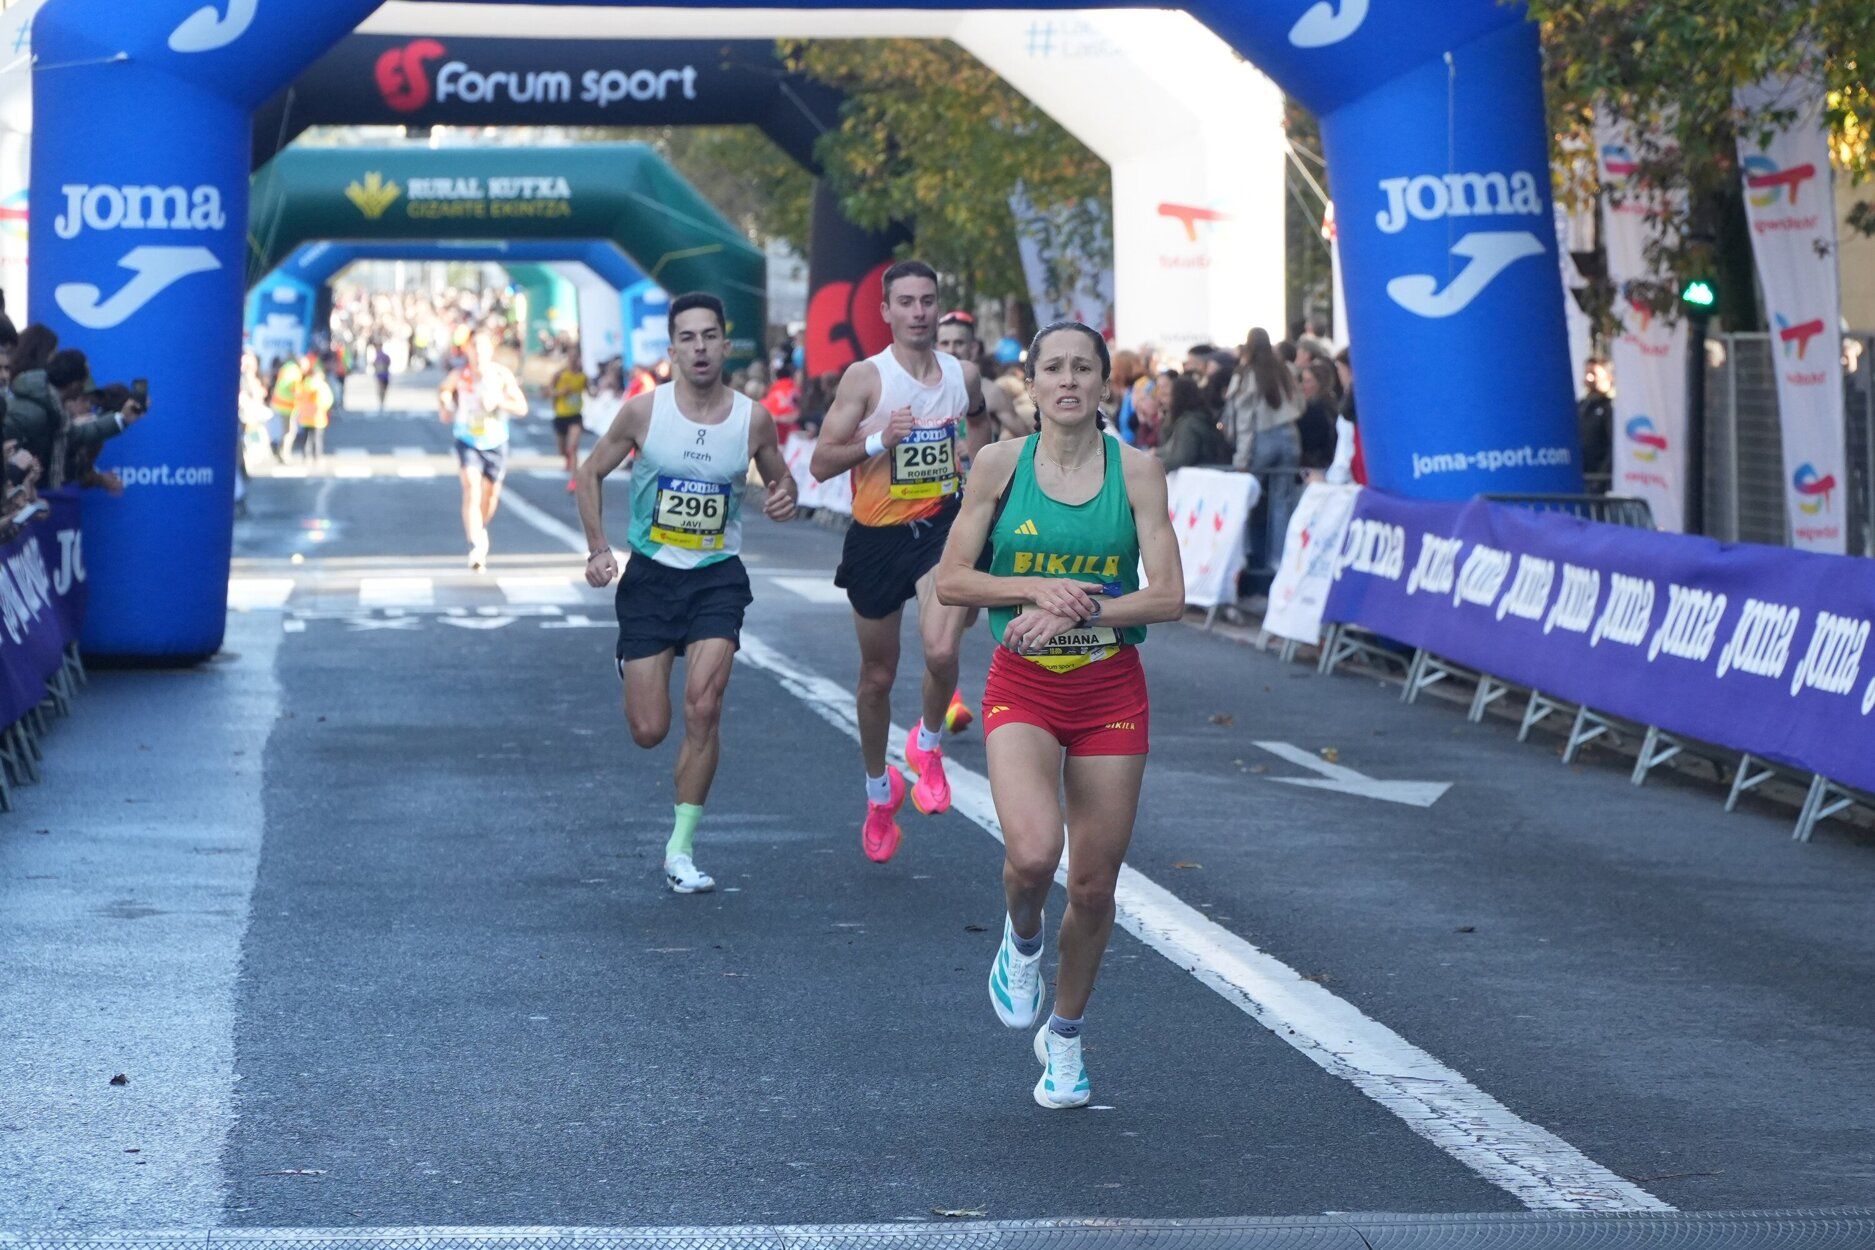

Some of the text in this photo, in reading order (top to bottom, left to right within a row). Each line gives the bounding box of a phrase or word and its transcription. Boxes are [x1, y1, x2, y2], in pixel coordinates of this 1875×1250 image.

[580, 64, 698, 109] sport
[407, 177, 485, 200] RURAL
[903, 443, 949, 467] 265
[907, 466, 948, 478] ROBERTO
[666, 495, 718, 518] 296
[681, 520, 702, 529] JAVI
[1013, 551, 1120, 577] BIKILA
[1049, 634, 1100, 646] ABIANA
